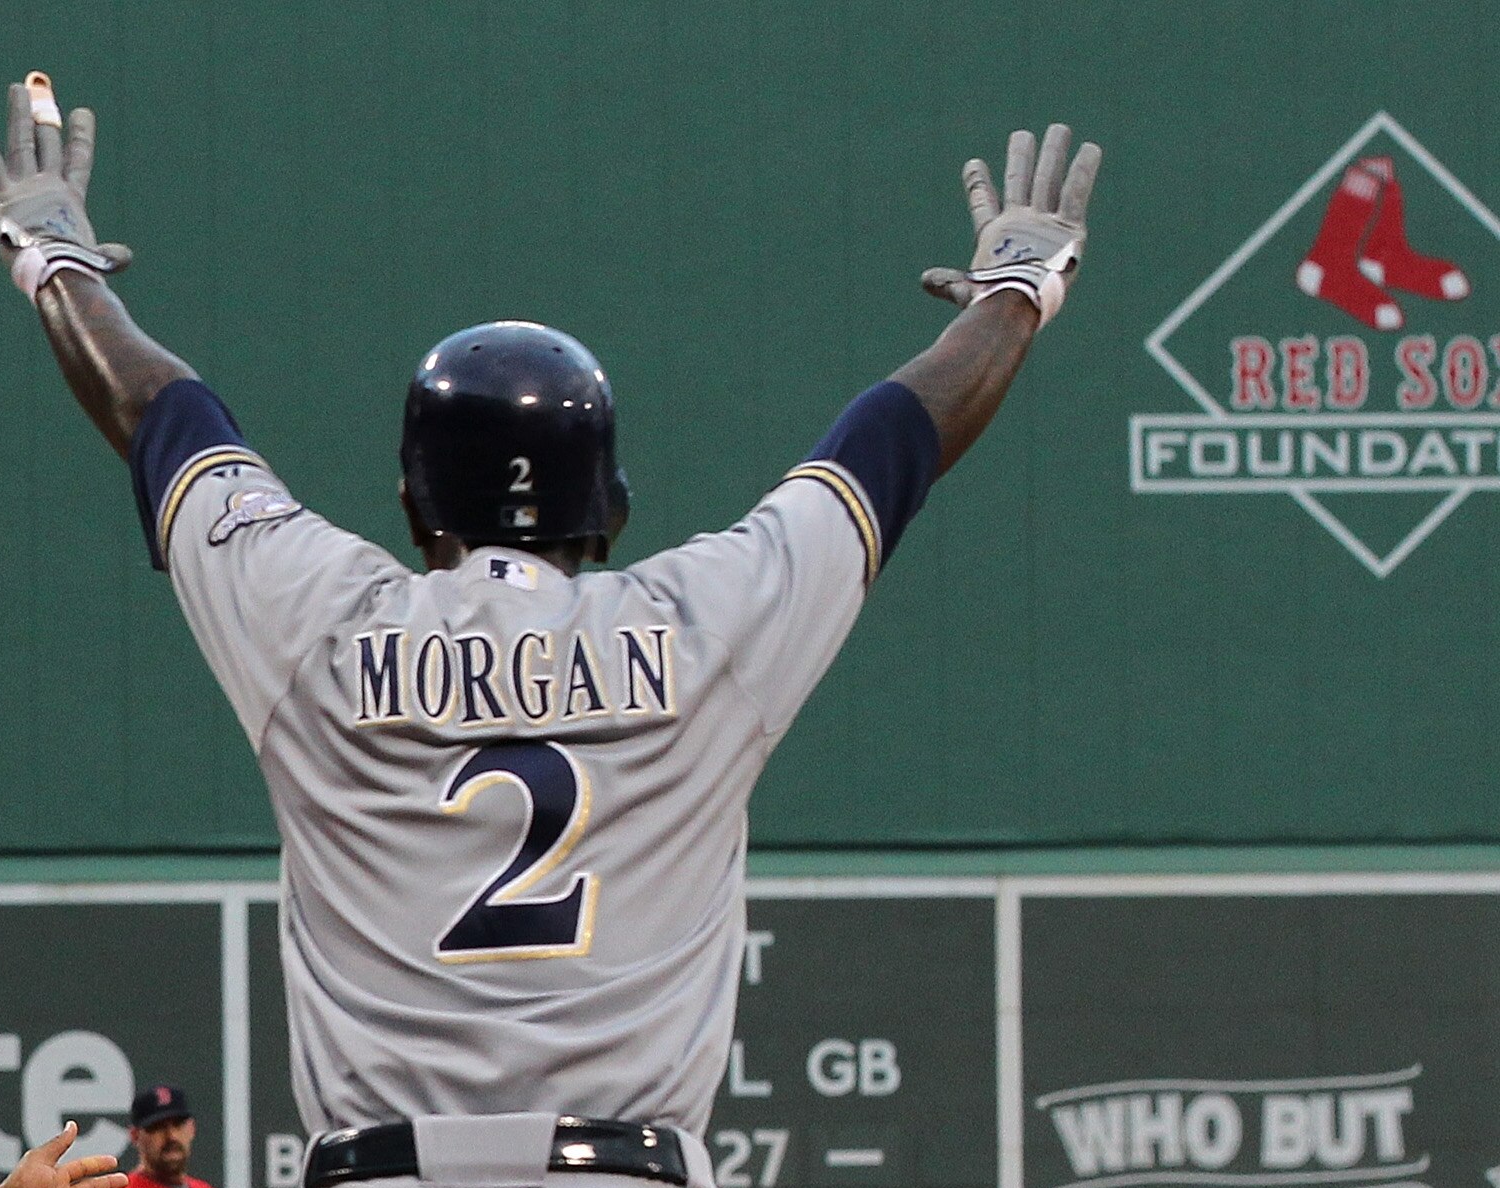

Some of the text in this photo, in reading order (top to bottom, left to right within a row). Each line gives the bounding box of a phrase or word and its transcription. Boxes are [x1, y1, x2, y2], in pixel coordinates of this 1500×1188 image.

[1231, 334, 1369, 411] RED
[508, 456, 534, 492] 2
[1147, 431, 1500, 476] FOUNDAT
[354, 626, 677, 729] MORGAN
[433, 738, 598, 964] 2
[729, 1038, 901, 1097] L GB
[714, 1128, 790, 1188] 27
[1051, 1086, 1414, 1178] WHO BUT
